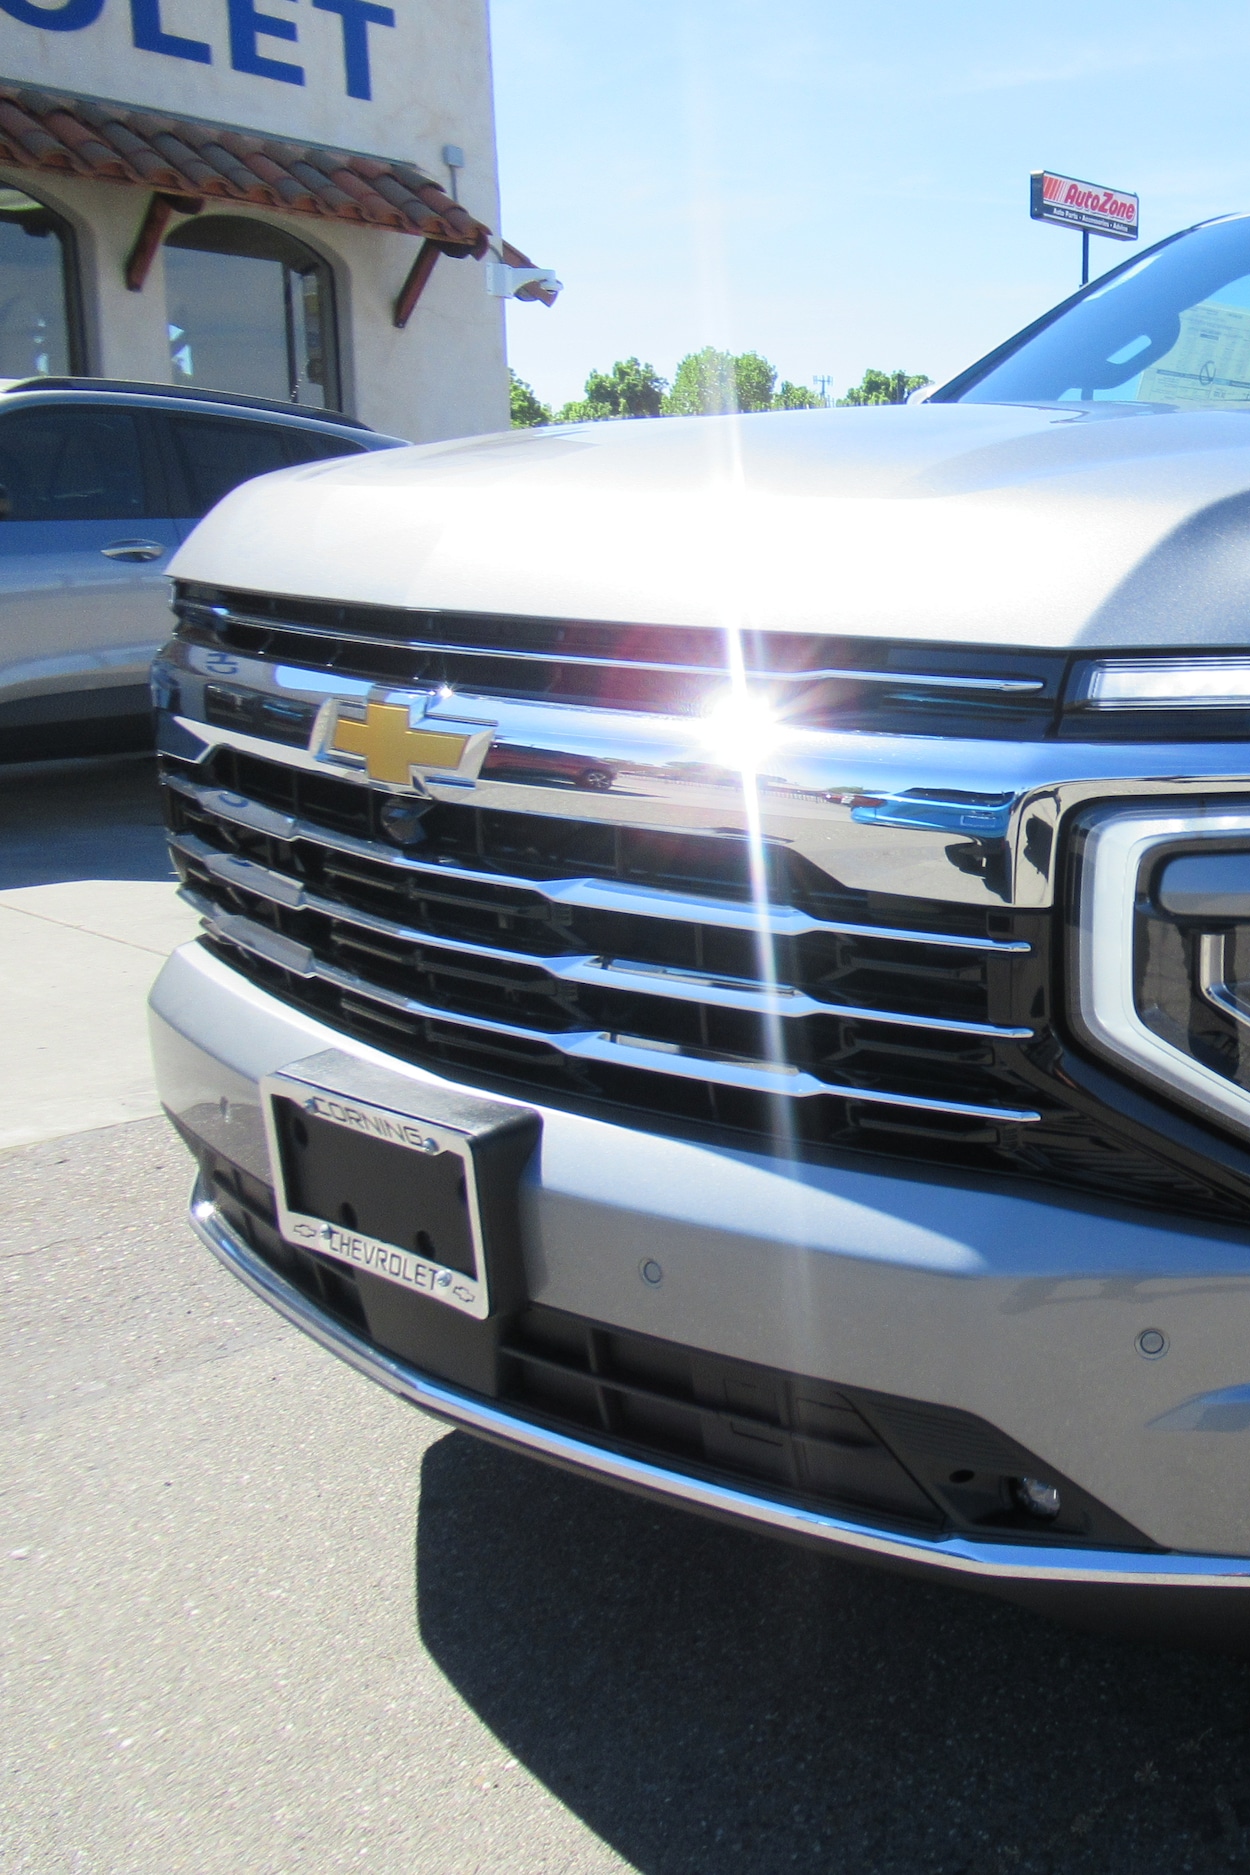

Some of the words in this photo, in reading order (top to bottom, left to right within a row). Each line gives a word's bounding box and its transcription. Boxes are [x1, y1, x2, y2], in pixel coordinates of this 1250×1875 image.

[1064, 183, 1136, 221] AutoZone
[313, 1096, 426, 1148] CORNING
[329, 1230, 439, 1291] CHEVROLET
